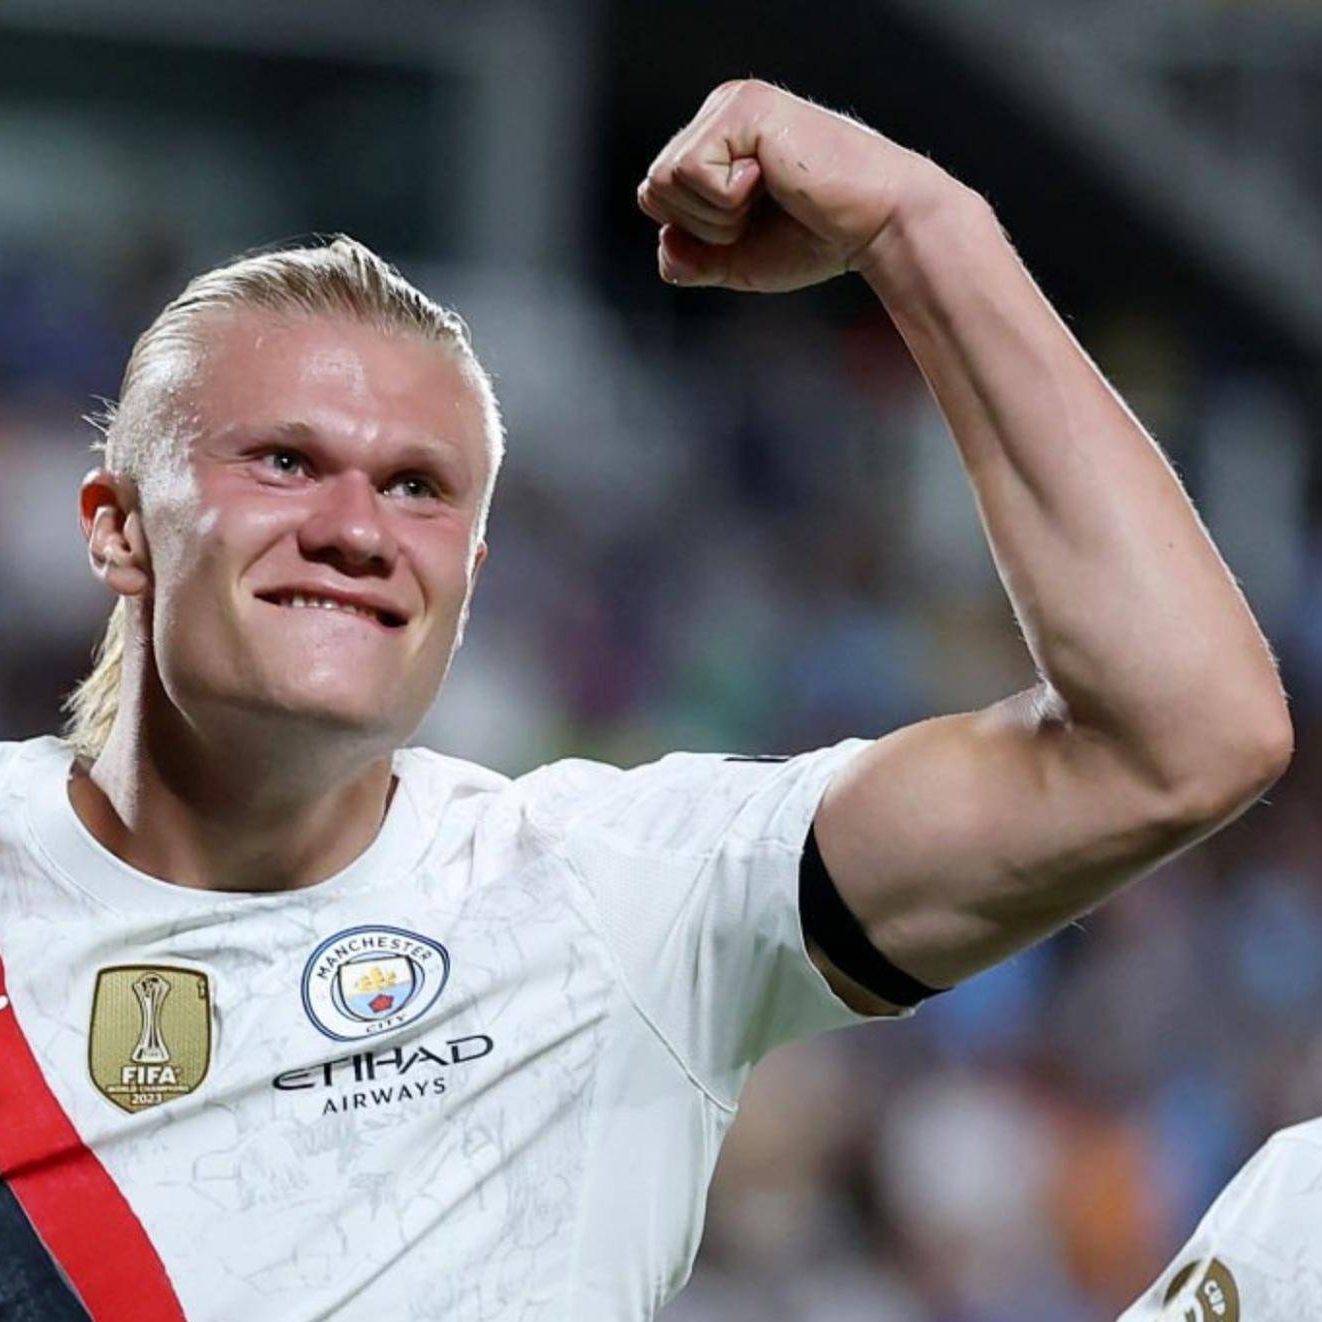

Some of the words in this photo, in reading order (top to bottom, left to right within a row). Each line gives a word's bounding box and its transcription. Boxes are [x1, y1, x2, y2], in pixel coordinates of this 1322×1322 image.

[317, 936, 432, 980] MANCHESTER
[366, 1013, 406, 1033] CITY
[122, 1065, 176, 1085] FIFA
[273, 1034, 494, 1091] ETIHAD
[131, 1093, 162, 1104] 2023
[322, 1077, 447, 1115] AIRWAYS
